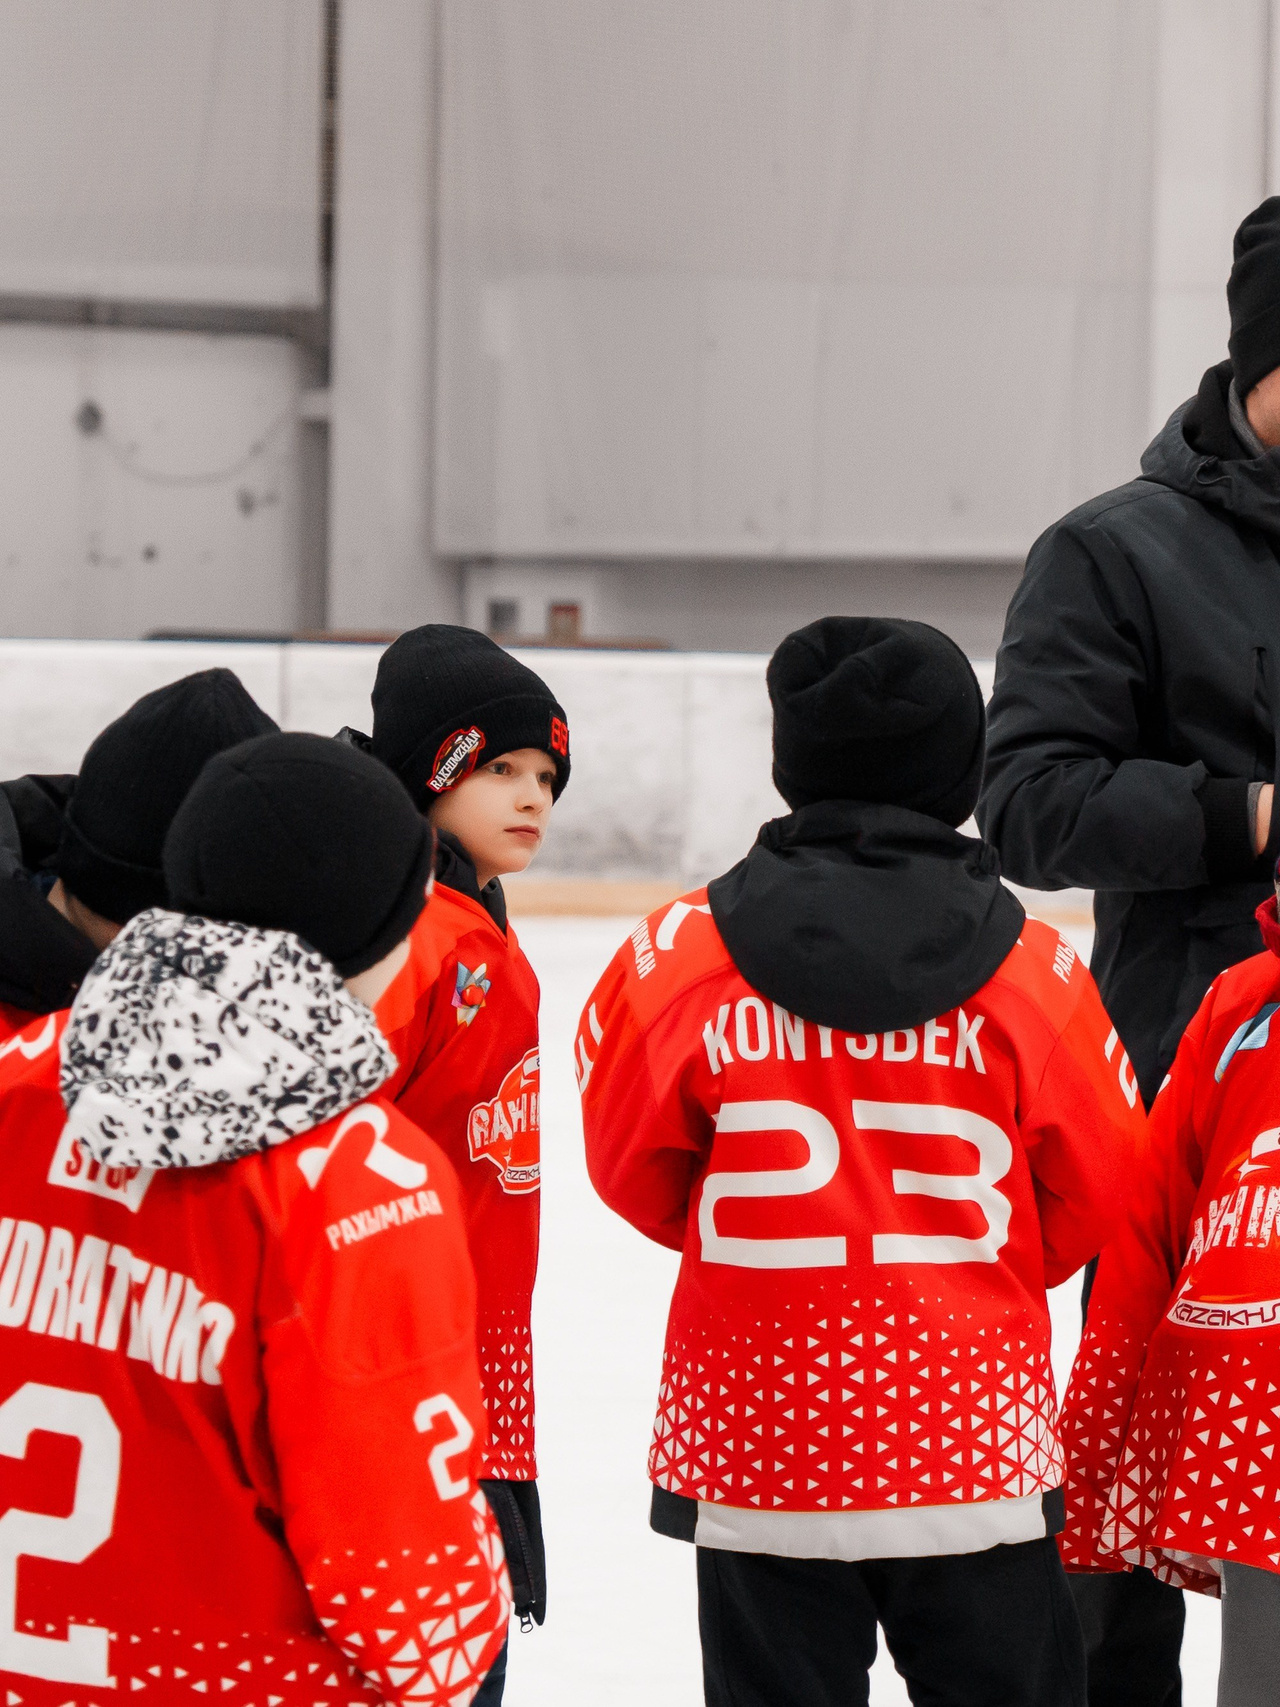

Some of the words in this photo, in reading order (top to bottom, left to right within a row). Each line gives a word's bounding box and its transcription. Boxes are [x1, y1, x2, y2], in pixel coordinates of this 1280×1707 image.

[430, 729, 481, 790] RAKHIMZHAN
[698, 1099, 1013, 1270] 23
[412, 1392, 475, 1502] 2
[0, 1381, 122, 1688] 2
